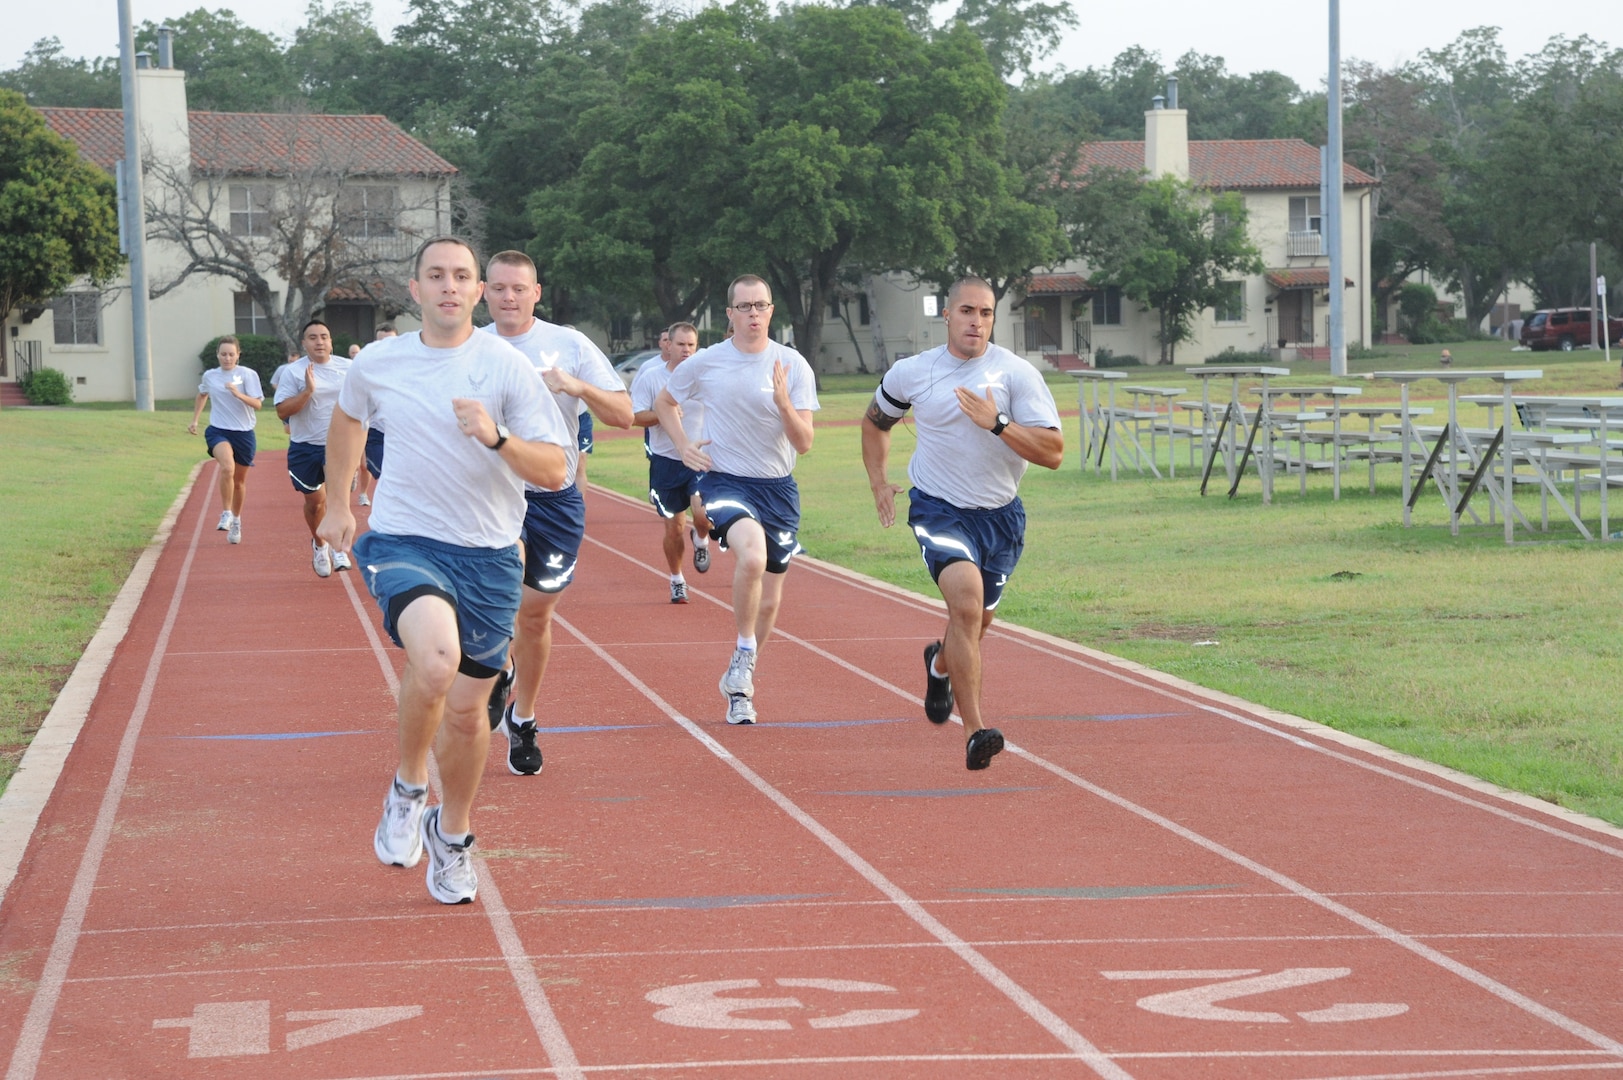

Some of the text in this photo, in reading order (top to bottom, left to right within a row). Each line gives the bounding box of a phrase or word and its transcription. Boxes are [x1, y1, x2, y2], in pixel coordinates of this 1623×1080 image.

[644, 977, 920, 1031] 3
[1100, 966, 1410, 1024] 2
[152, 999, 424, 1059] 4
